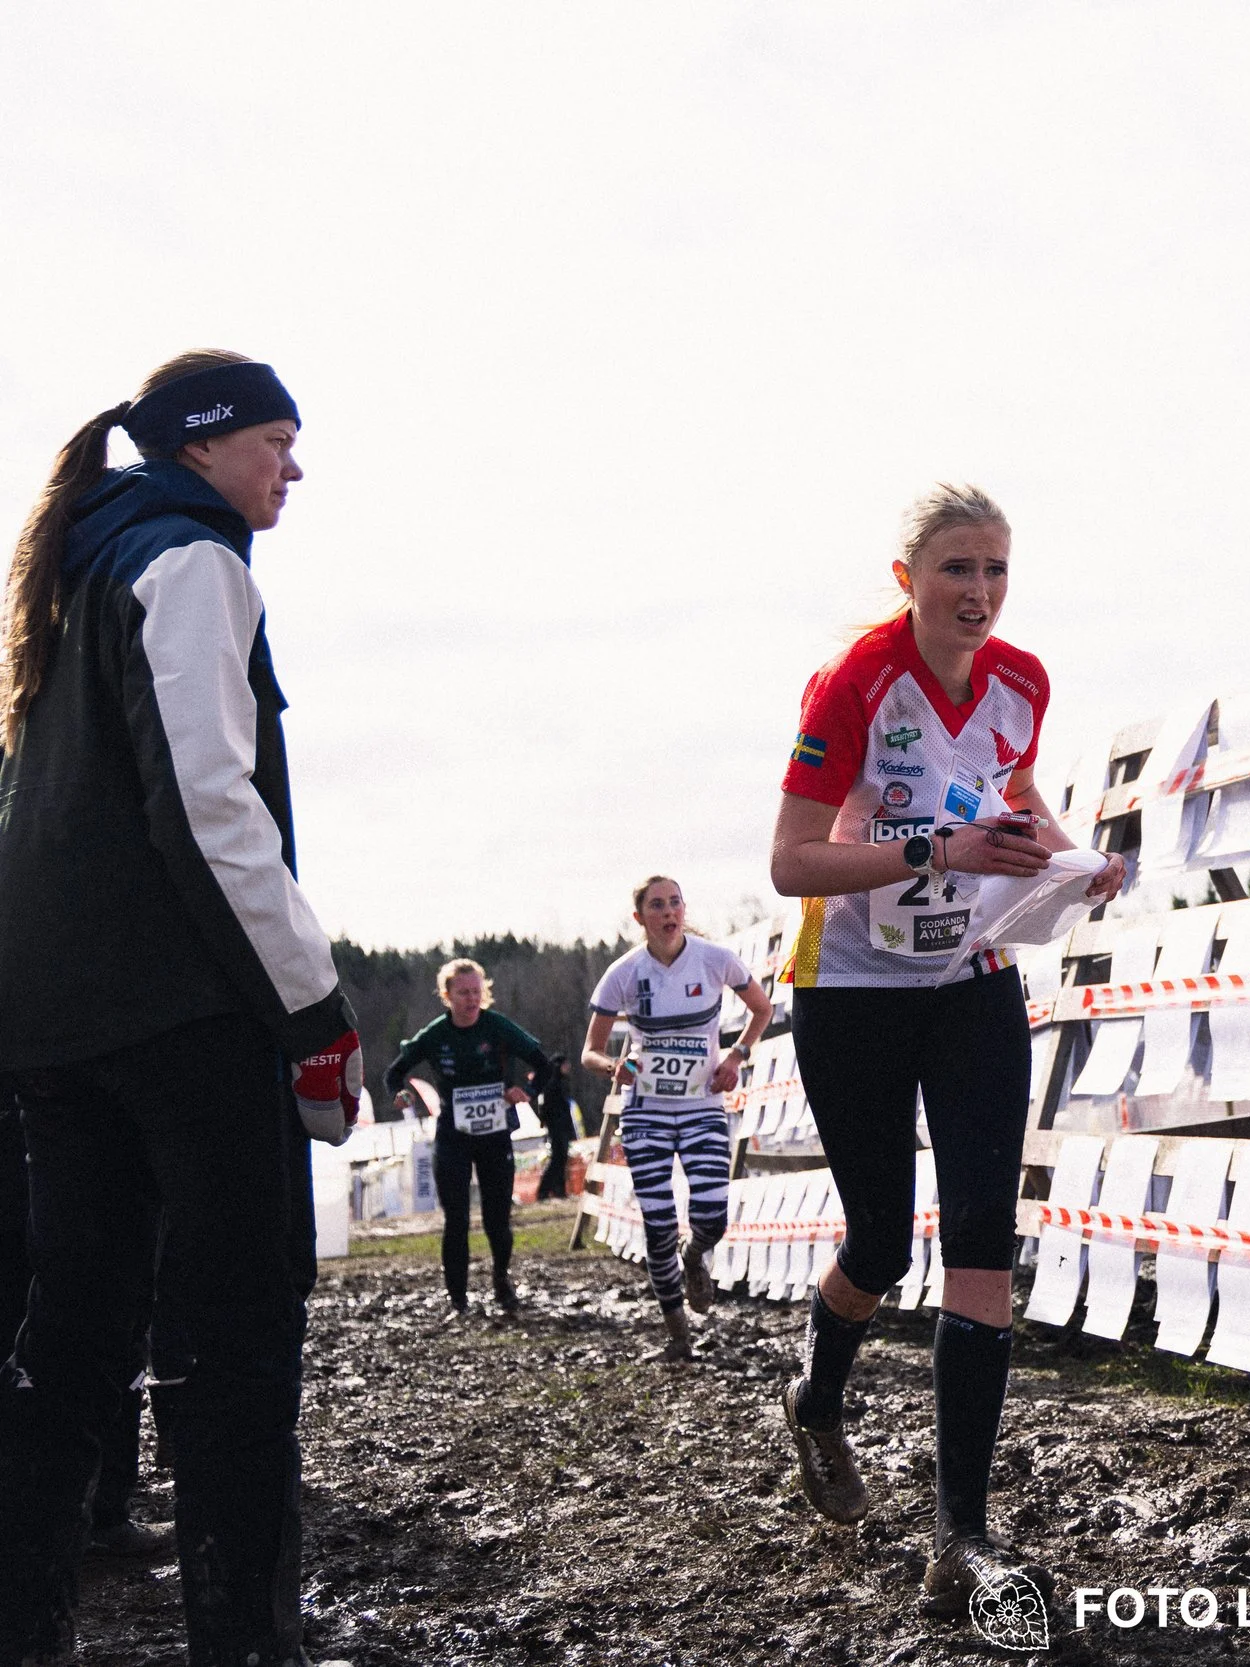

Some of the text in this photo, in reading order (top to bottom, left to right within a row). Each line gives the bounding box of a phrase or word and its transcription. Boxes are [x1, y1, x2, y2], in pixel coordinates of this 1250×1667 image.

[919, 916, 966, 929] GODKÄNDA
[650, 1057, 697, 1077] 207
[464, 1102, 497, 1119] 204
